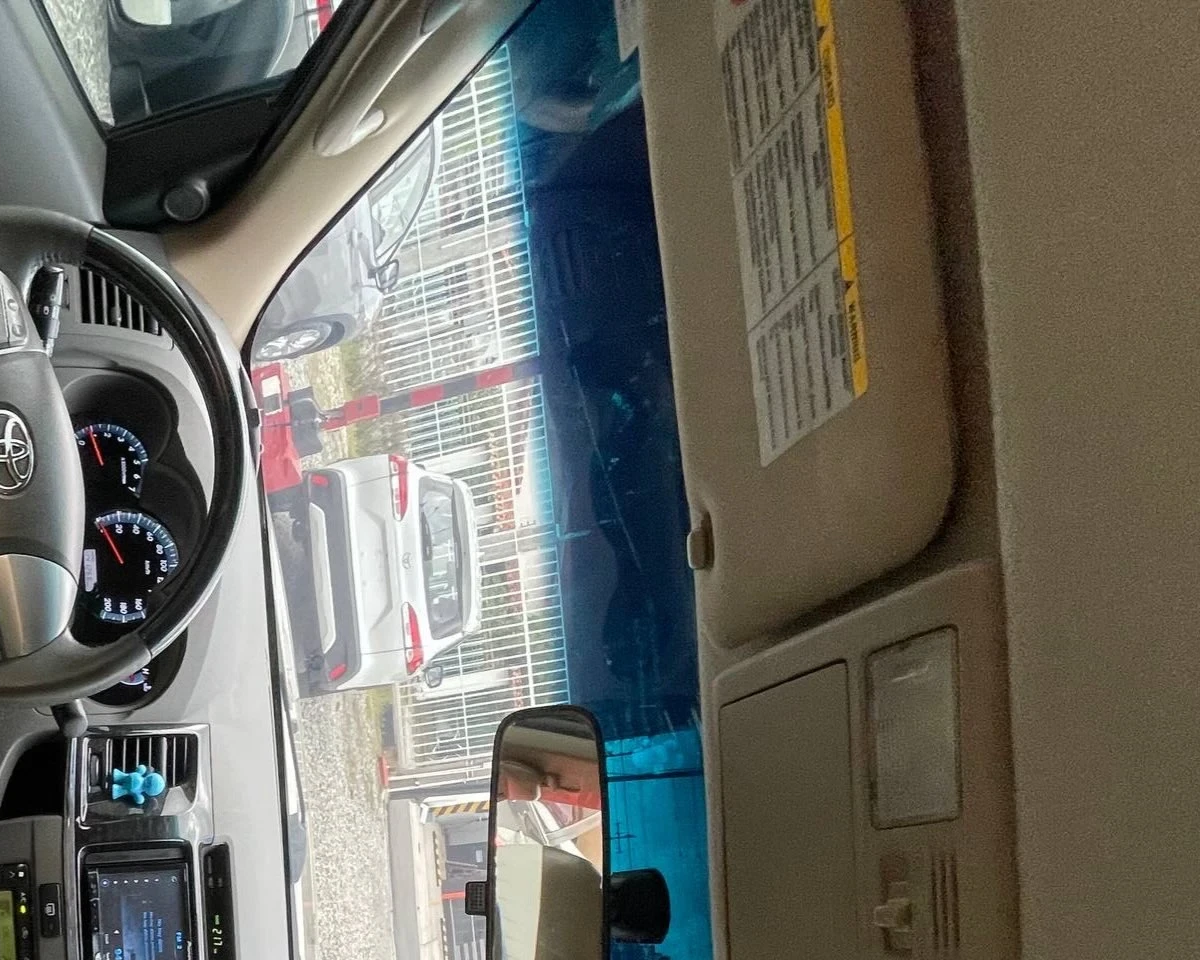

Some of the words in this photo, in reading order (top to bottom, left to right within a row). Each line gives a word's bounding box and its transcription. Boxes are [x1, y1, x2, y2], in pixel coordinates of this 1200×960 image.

[115, 523, 124, 535] 20
[132, 524, 141, 535] 40
[146, 531, 154, 542] 60
[155, 543, 164, 555] 80
[159, 559, 168, 572] 100
[103, 597, 112, 612] 200
[119, 601, 128, 615] 180
[134, 598, 143, 611] 160
[212, 928, 223, 946] 217
